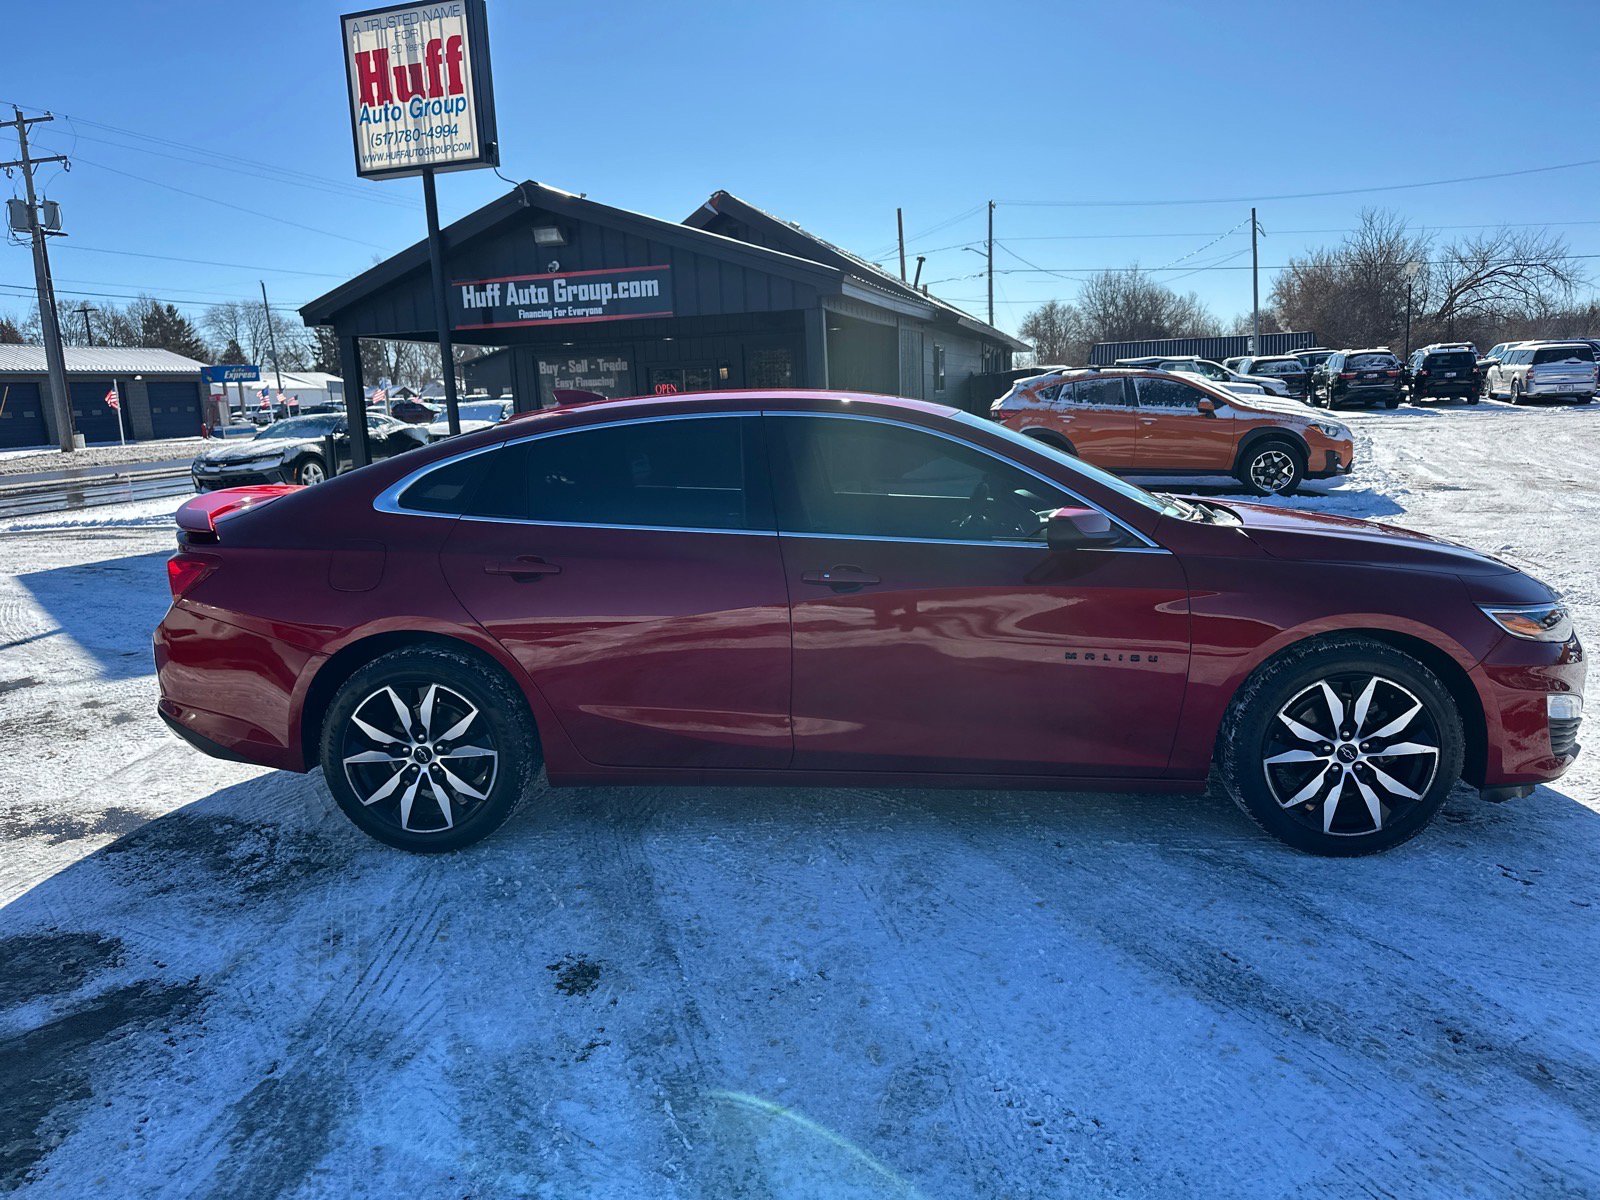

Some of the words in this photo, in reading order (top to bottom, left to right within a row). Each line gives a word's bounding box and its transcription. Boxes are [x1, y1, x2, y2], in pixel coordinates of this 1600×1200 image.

[352, 22, 361, 34] A
[364, 13, 419, 31] TRUSTED
[423, 4, 461, 22] NAME
[395, 28, 418, 40] FOR
[355, 35, 464, 108] Huff
[359, 104, 402, 125] Auto
[409, 96, 467, 117] Group
[370, 123, 459, 149] (517)780-4994
[363, 142, 471, 164] WWW.HUFFAUTOGROUP.COM
[462, 284, 500, 308] Huff
[506, 282, 549, 306] Auto
[553, 278, 659, 305] Group.com
[518, 308, 553, 320] Financing
[553, 306, 567, 317] For
[567, 305, 603, 317] Everyone
[224, 370, 256, 381] Express
[539, 361, 559, 377] Buy
[568, 359, 589, 374] Sell
[597, 358, 628, 372] Trade
[555, 377, 574, 389] Easy
[575, 376, 615, 388] Financing
[655, 383, 677, 395] OPEN
